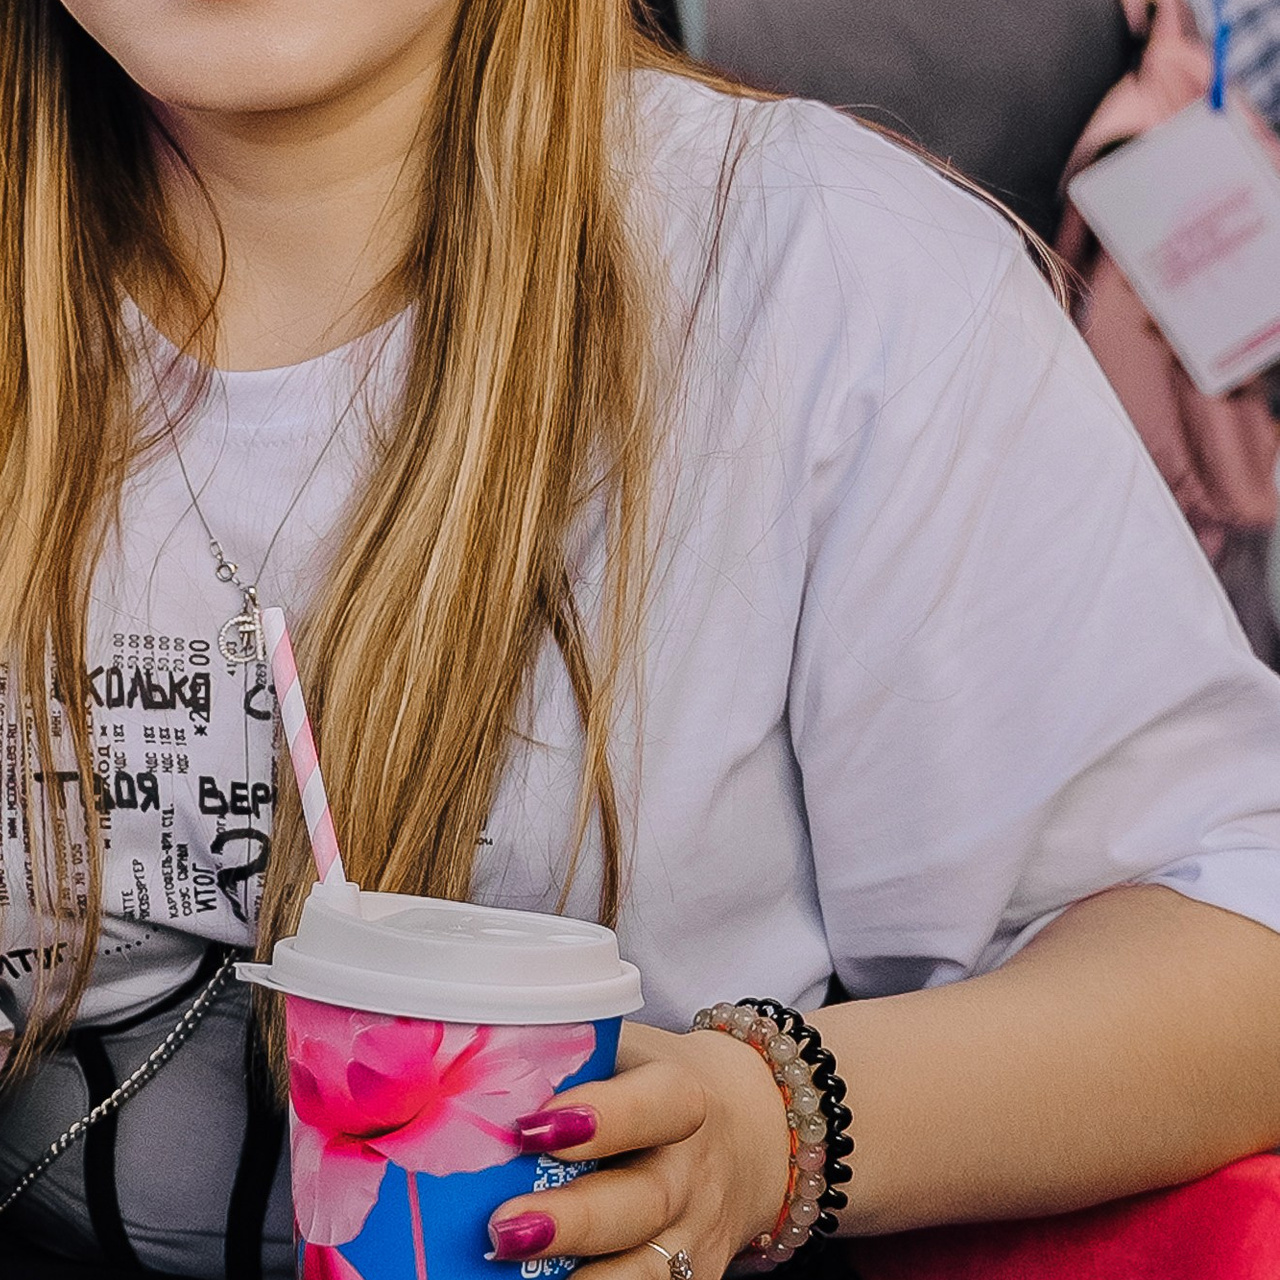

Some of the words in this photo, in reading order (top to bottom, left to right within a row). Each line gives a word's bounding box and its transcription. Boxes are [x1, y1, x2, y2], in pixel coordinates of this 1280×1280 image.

[158, 635, 171, 671] 50.00
[173, 637, 186, 673] 20.00
[160, 753, 174, 774] НДС
[175, 753, 190, 774] НДС
[178, 886, 193, 917] СОУС
[191, 863, 217, 913] ИТОГ
